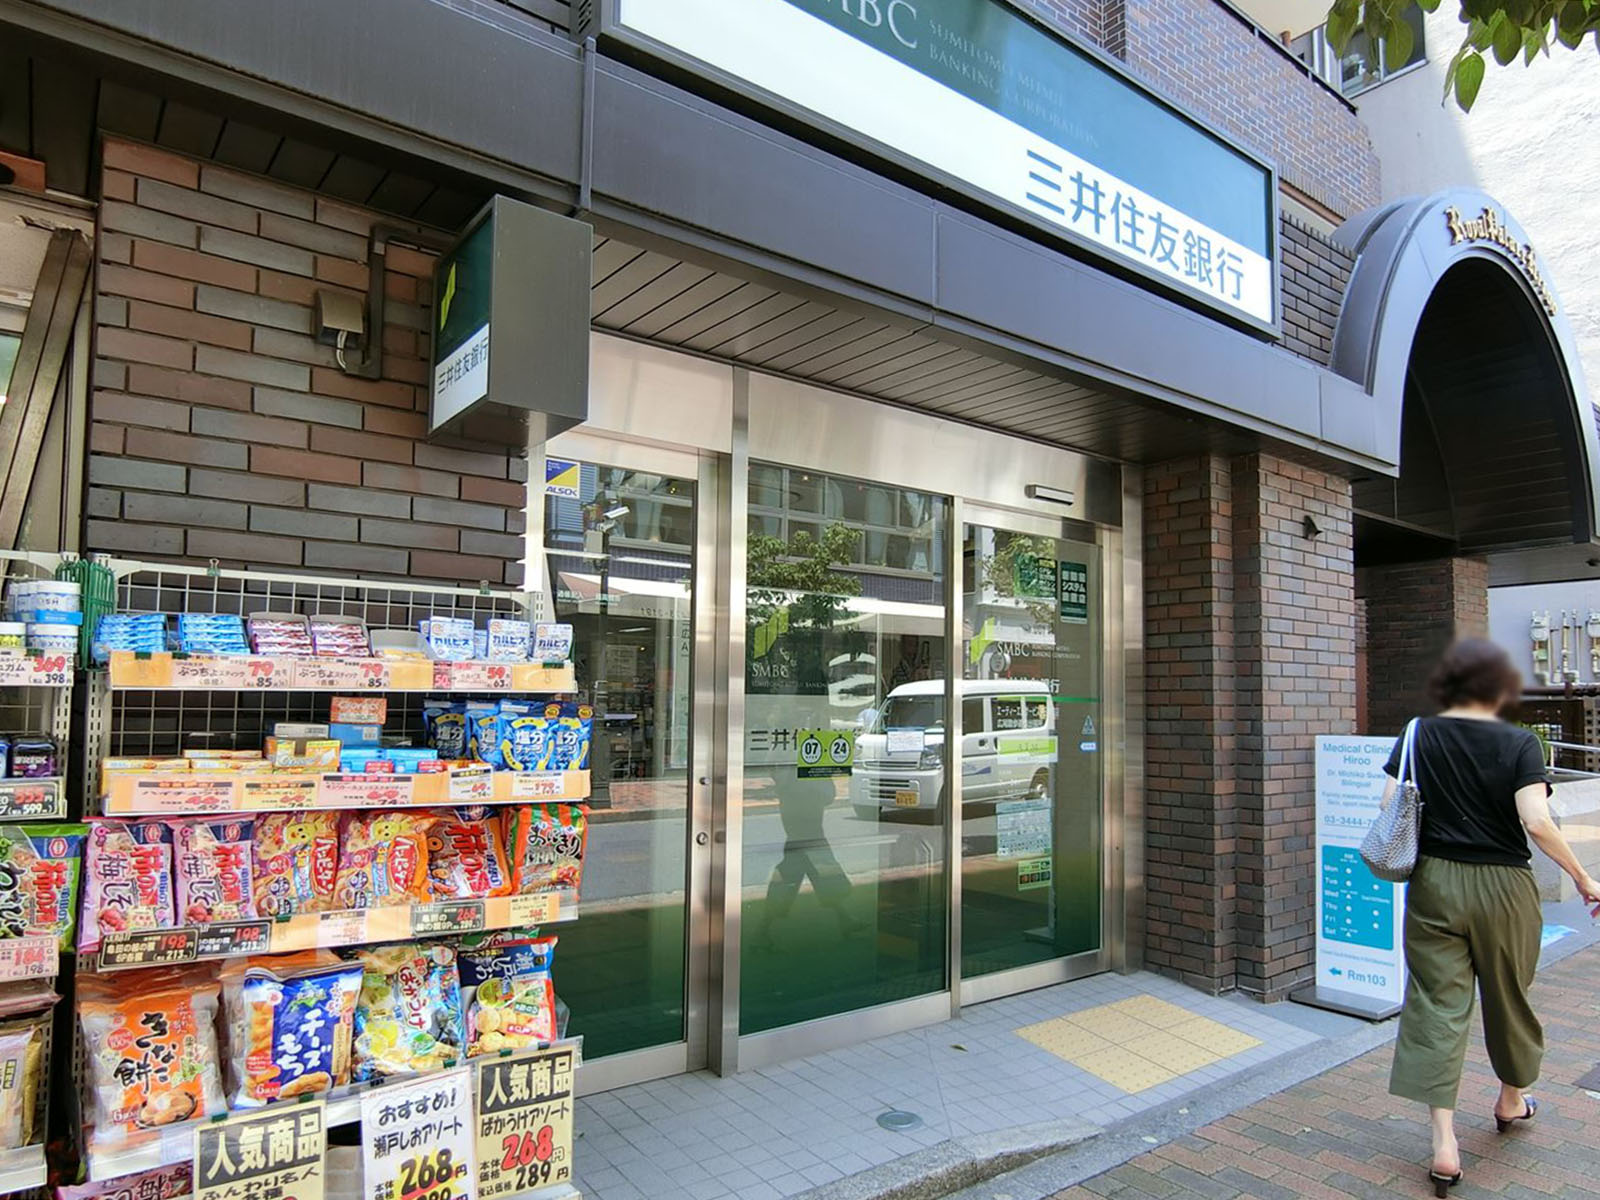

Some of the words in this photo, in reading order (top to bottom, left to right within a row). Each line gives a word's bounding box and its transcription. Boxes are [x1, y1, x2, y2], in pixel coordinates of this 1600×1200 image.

[928, 43, 1001, 95] BANKING
[1026, 149, 1244, 301] 三井住友銀行
[437, 336, 488, 394] 三井住友銀行
[546, 486, 578, 497] ALSOK
[997, 642, 1030, 657] SMBC
[33, 655, 66, 673] 369
[248, 660, 275, 677] 79
[360, 663, 384, 678] 79
[751, 662, 789, 678] SMBC
[45, 673, 65, 684] 398
[256, 677, 273, 687] 85
[368, 678, 382, 688] 85
[437, 726, 465, 740] 塩分
[515, 730, 545, 745] 塩分
[804, 742, 818, 755] 07
[834, 742, 847, 755] 24
[1323, 743, 1361, 753] Medical
[1363, 743, 1393, 754] Clinic
[1343, 756, 1371, 765] Hiroo
[1324, 864, 1338, 872] Mon
[1325, 877, 1338, 885] Tue
[1325, 902, 1338, 910] Thu
[235, 928, 260, 942] 198
[1325, 927, 1336, 935] Sat
[160, 935, 188, 950] 198
[166, 950, 184, 961] 213
[1347, 969, 1386, 987] Rm103
[400, 966, 427, 1030] ばかうけ
[300, 1008, 332, 1070] チーズ
[277, 1033, 305, 1076] もち
[486, 1056, 571, 1108] 人気商品
[481, 1102, 569, 1138] ばかうけアソート
[374, 1115, 463, 1159] 瀬戸しおアソート
[207, 1112, 321, 1181] 人気商品
[501, 1124, 554, 1171] 268
[552, 1146, 565, 1163] 円
[400, 1148, 452, 1196] 268
[455, 1163, 468, 1178] 円
[480, 1158, 500, 1171] 本体
[203, 1167, 320, 1200] ふんわり名人
[480, 1170, 500, 1182] 価格
[516, 1162, 552, 1191] 289
[557, 1166, 569, 1180] 円
[375, 1181, 394, 1193] 本体
